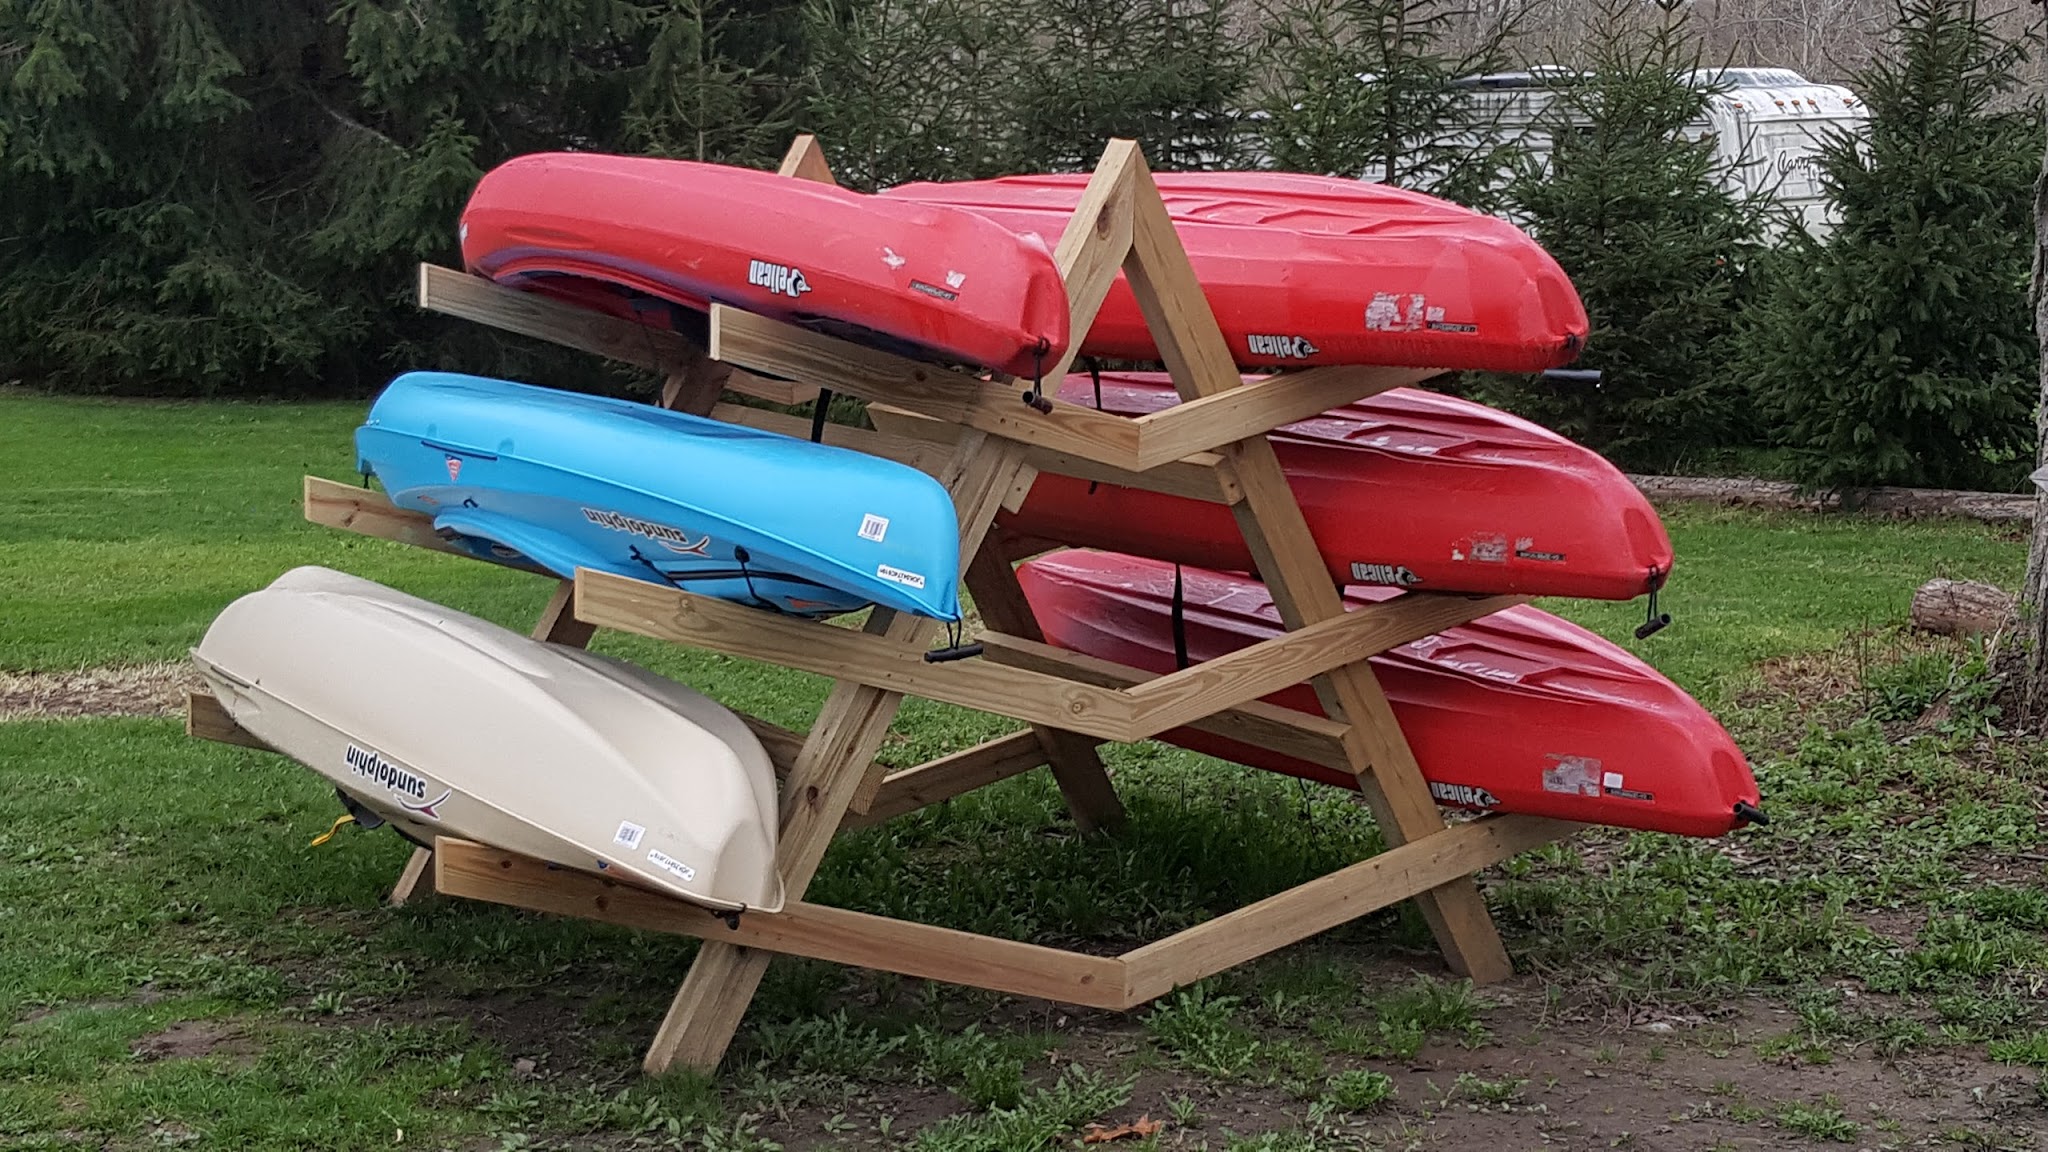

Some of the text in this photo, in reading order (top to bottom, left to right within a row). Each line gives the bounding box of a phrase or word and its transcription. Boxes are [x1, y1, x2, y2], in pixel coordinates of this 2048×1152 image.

[747, 259, 808, 298] Pelican
[1247, 334, 1310, 359] Pelican
[581, 507, 688, 545] sundolphin
[1350, 561, 1413, 586] Pelican
[345, 744, 427, 800] sundolphin
[1430, 781, 1491, 807] Pelican
